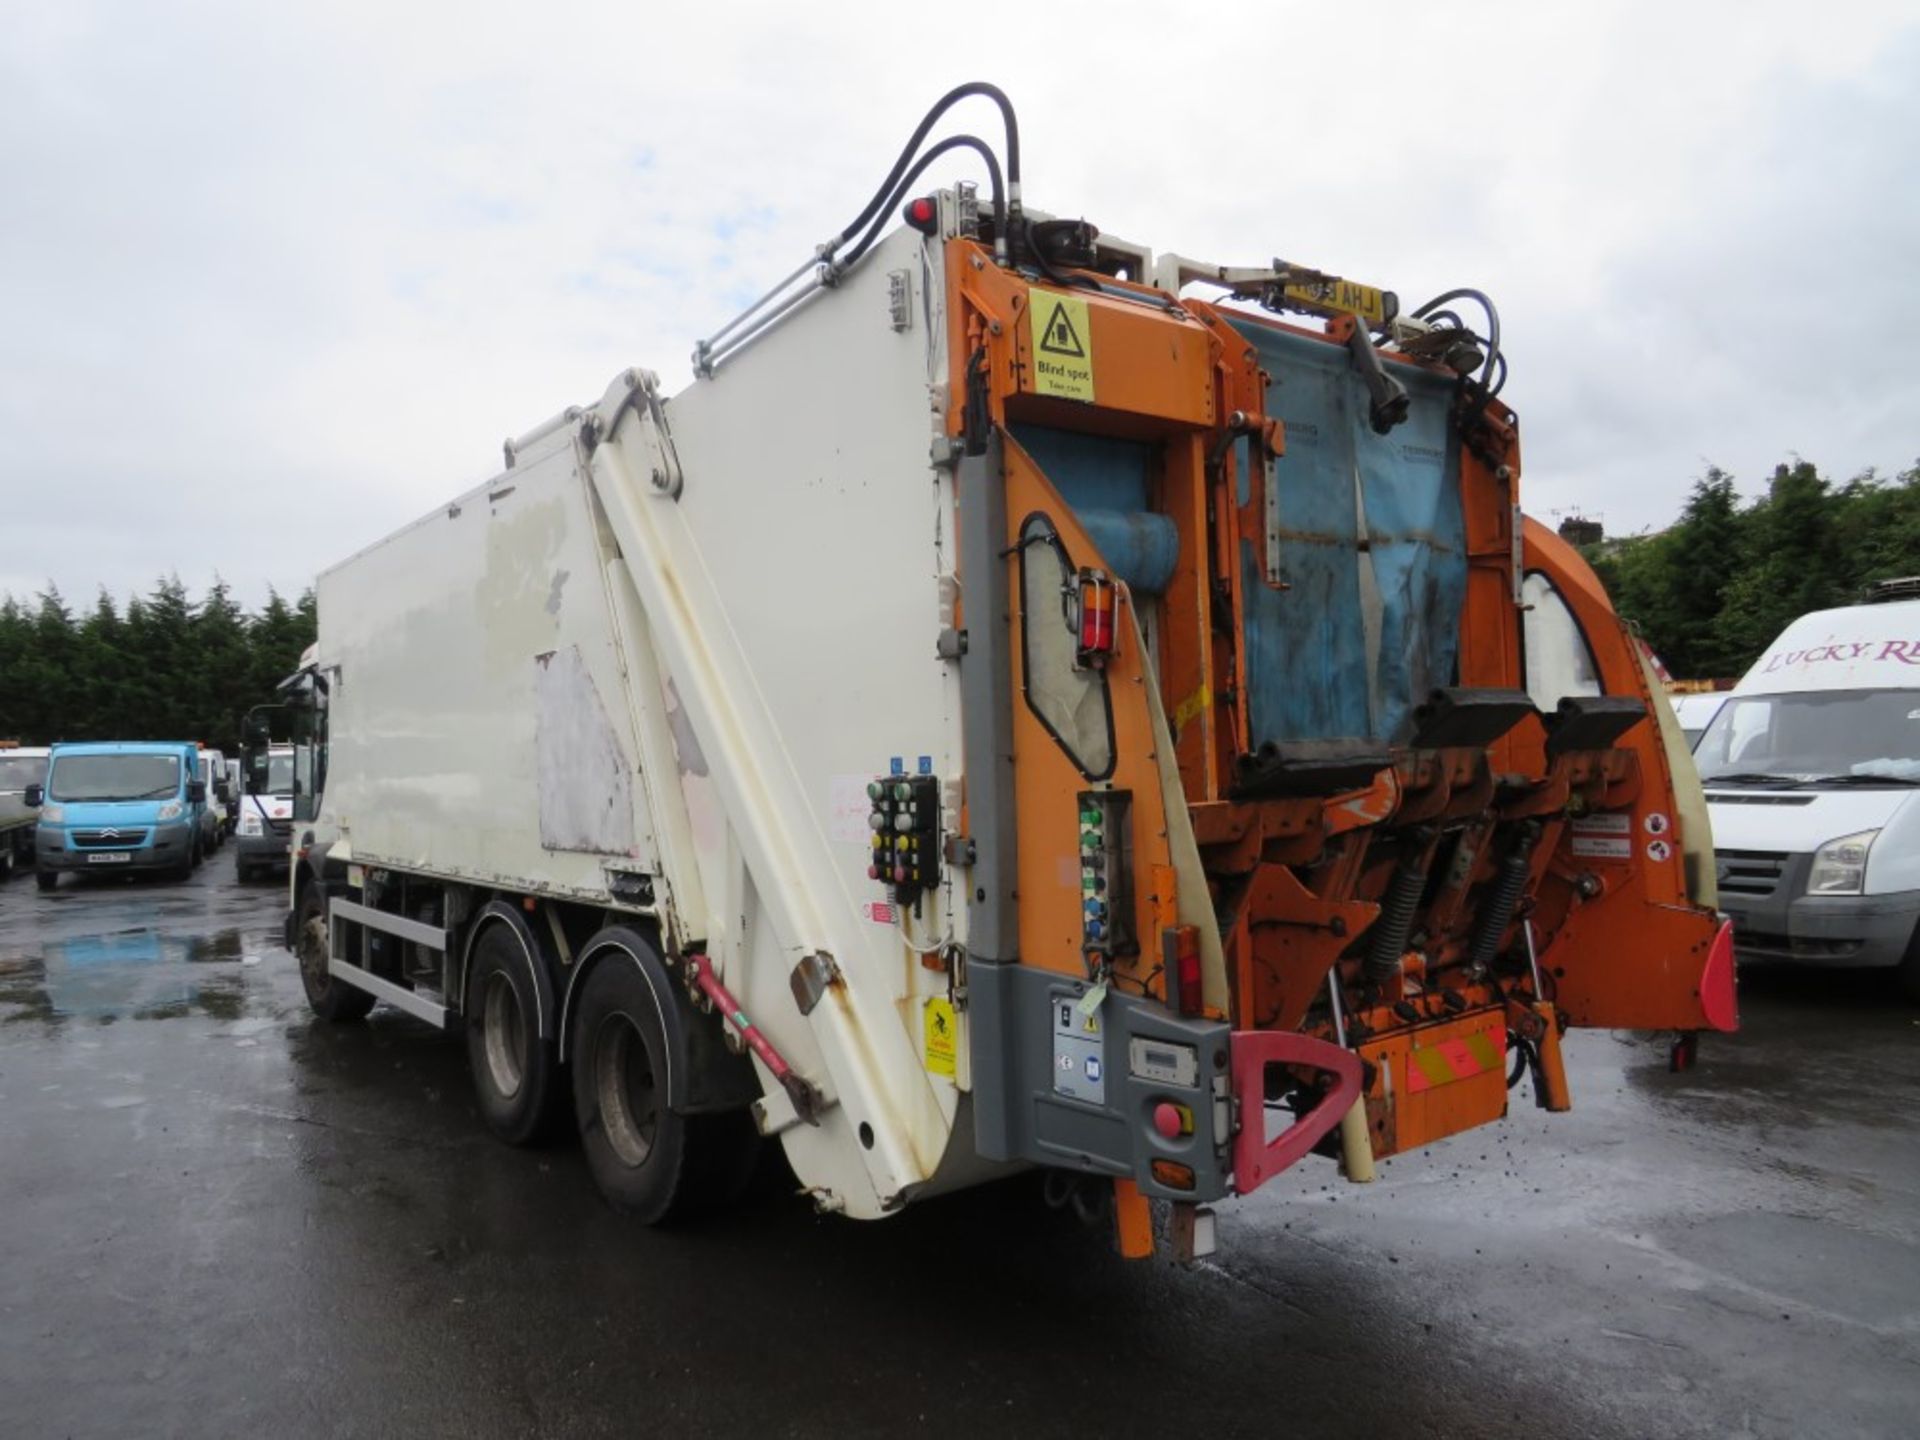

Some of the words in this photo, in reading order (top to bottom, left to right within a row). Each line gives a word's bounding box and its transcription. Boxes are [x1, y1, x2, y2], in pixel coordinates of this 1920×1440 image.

[1342, 284, 1374, 313] AHJ
[1038, 360, 1065, 376] Blind
[1762, 642, 1873, 673] LUCKY
